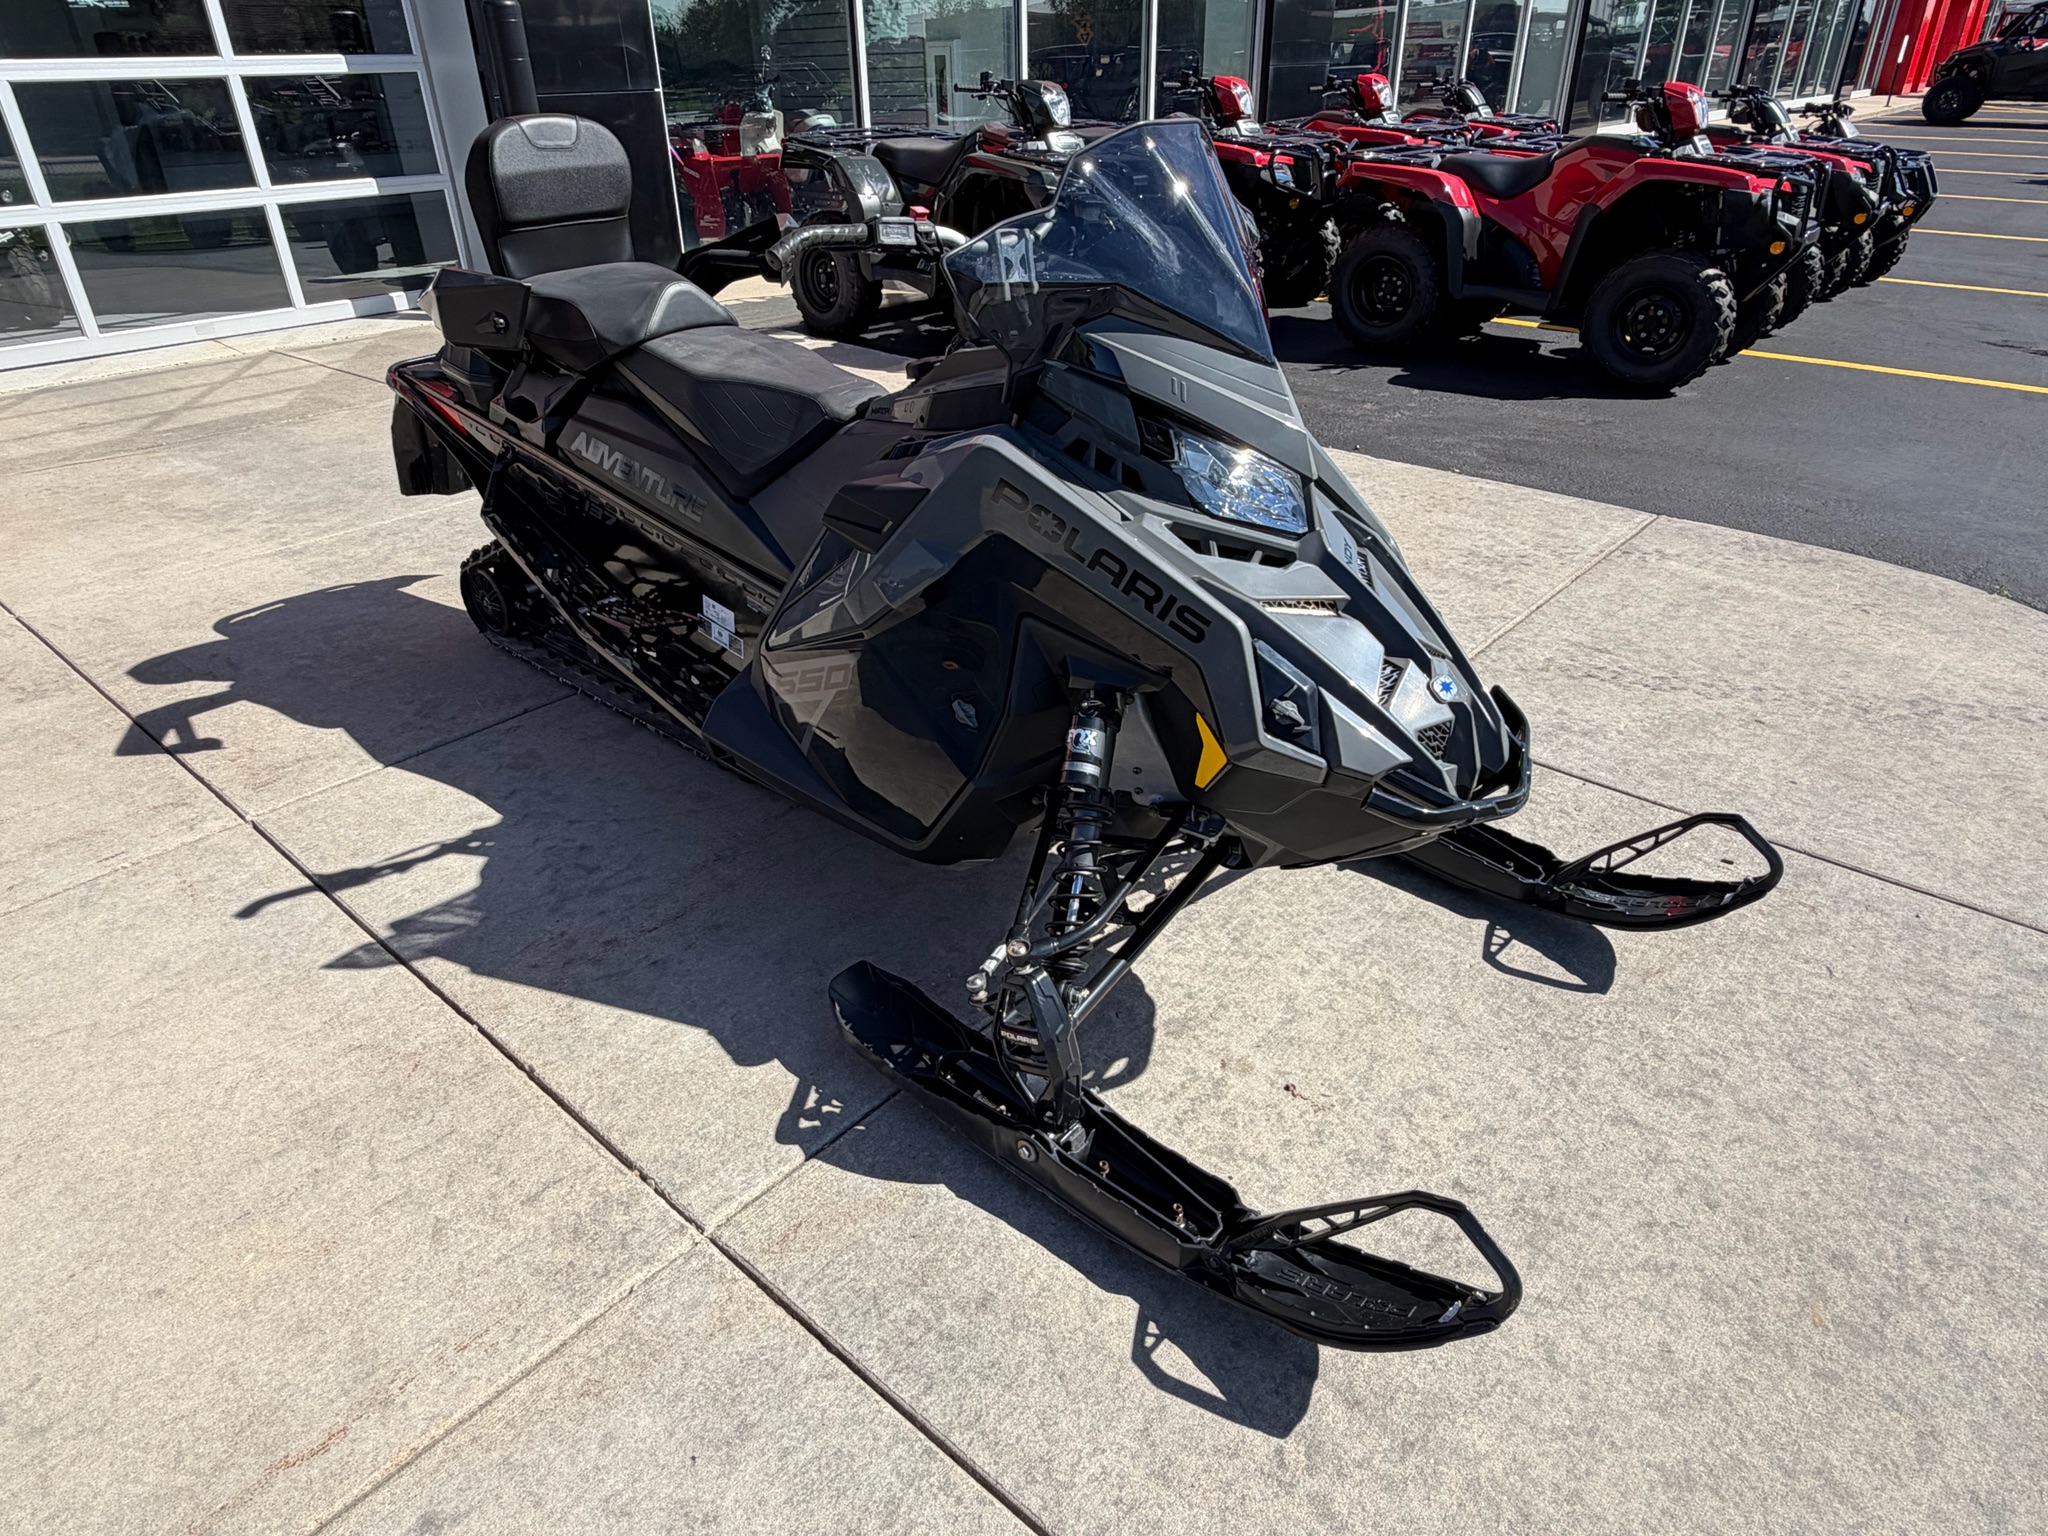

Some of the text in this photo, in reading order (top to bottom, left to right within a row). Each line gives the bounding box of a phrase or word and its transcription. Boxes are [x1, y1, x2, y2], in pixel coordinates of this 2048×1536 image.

[570, 431, 708, 523] ADVENTURE
[991, 477, 1213, 644] POLARIS
[1001, 1030, 1039, 1046] POLARIS
[1278, 1268, 1417, 1318] POLARIS
